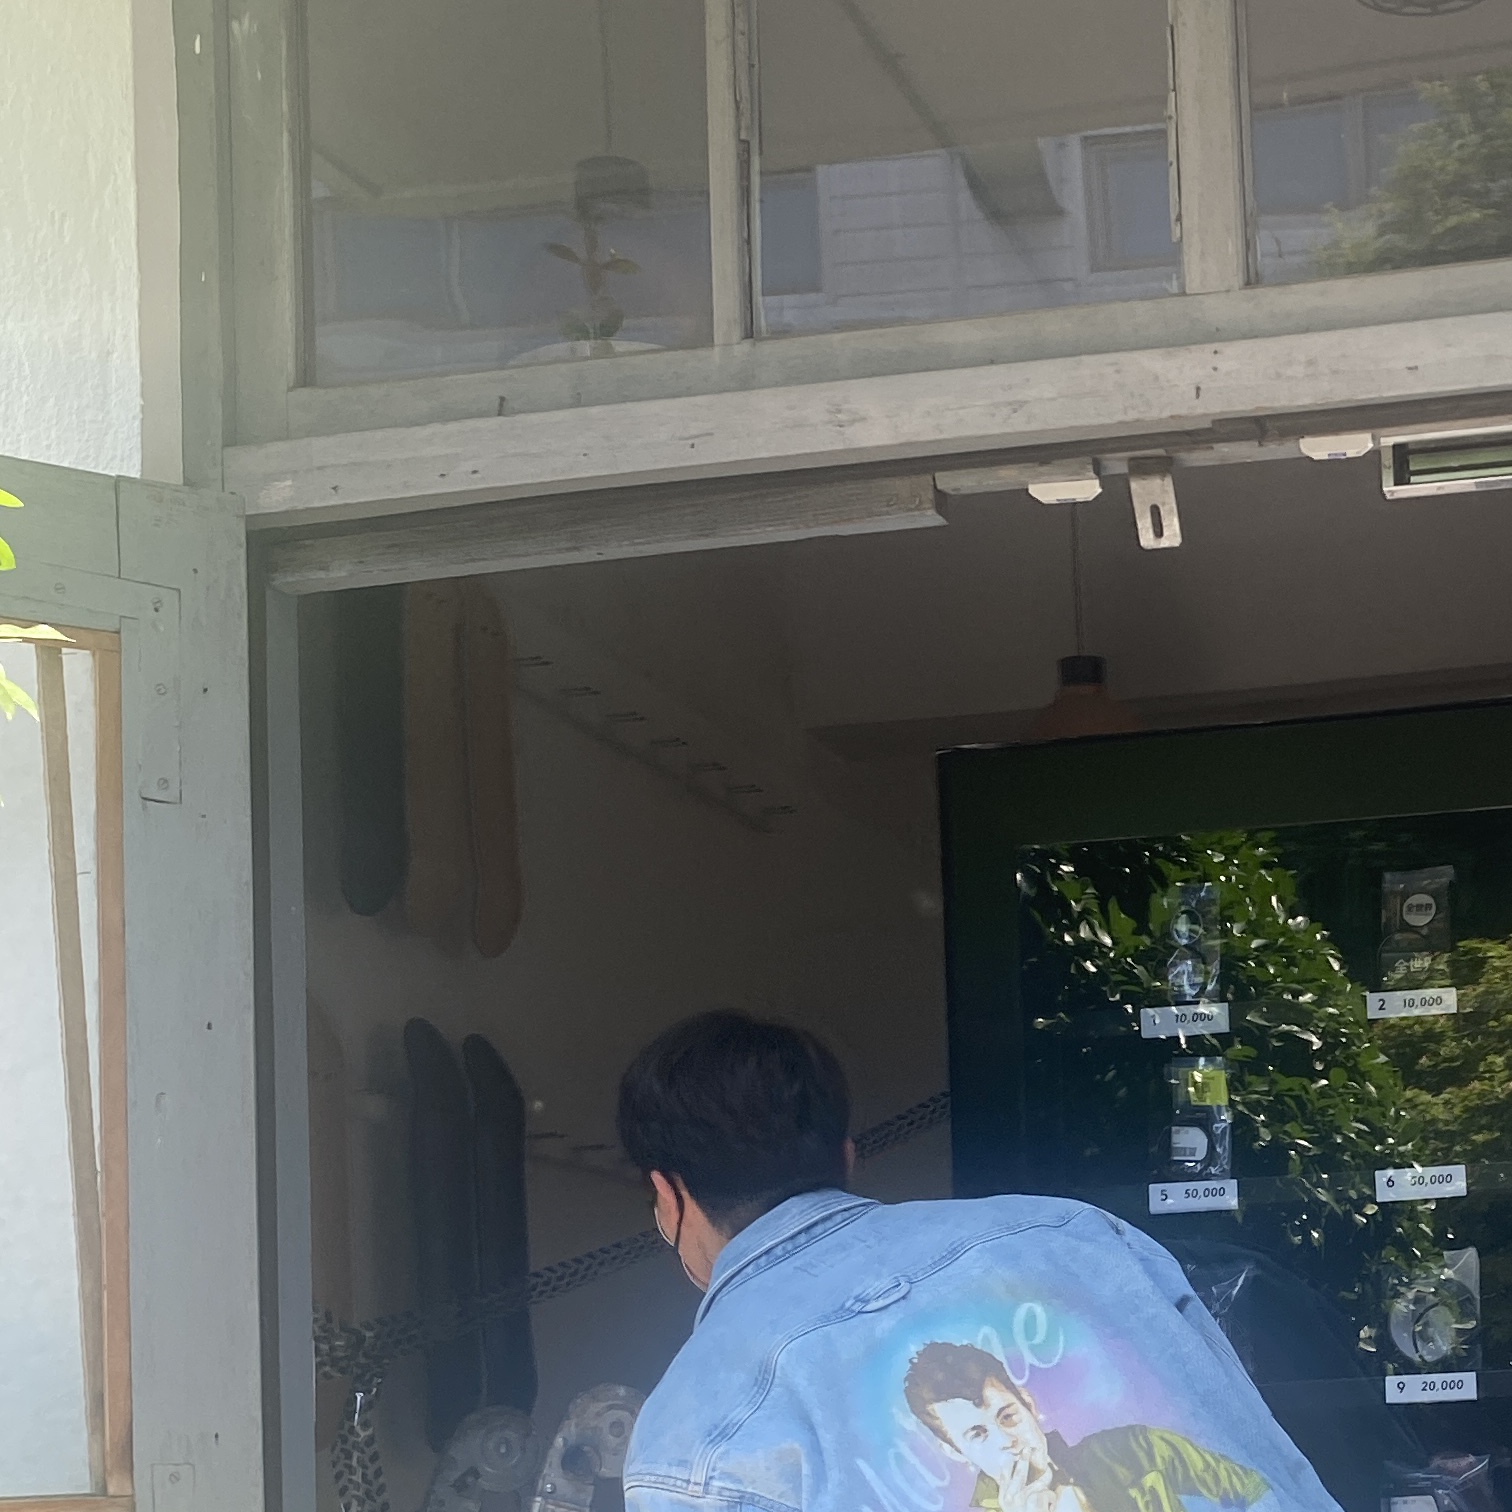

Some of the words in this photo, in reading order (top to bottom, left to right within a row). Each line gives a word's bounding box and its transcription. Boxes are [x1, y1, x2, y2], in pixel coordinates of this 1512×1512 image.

[1378, 998, 1386, 1011] 2
[1402, 995, 1443, 1010] 10,000
[1174, 1012, 1214, 1025] 10,000
[1385, 1176, 1395, 1188] 6
[1410, 1172, 1453, 1187] 50,000
[1159, 1189, 1168, 1201] 5
[1183, 1186, 1226, 1200] 50,000
[1396, 1381, 1406, 1394] 9
[1420, 1379, 1464, 1393] 20,000
